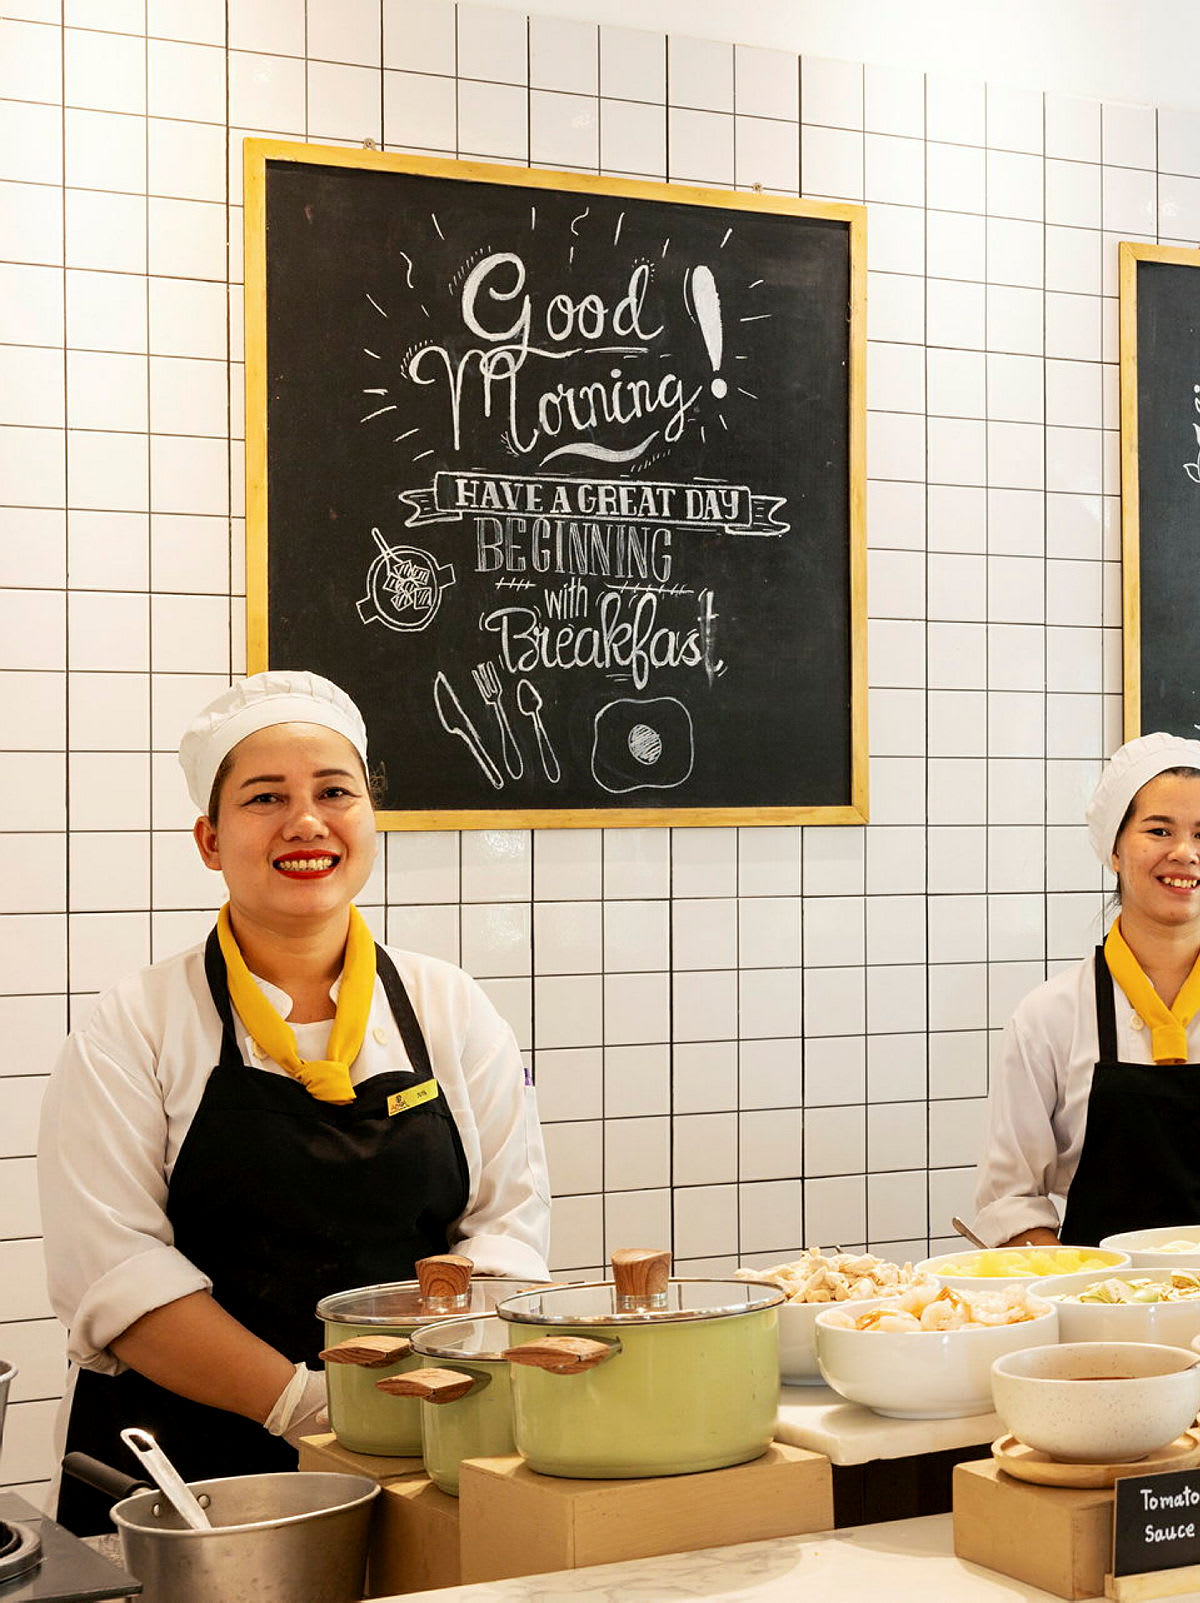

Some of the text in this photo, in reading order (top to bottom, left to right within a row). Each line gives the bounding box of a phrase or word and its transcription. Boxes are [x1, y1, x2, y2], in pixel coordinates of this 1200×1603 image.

[461, 252, 665, 358] Good
[455, 478, 740, 521] HAVE A GREAT DAY
[473, 517, 672, 583] BEGINNING
[544, 577, 589, 620] with
[1140, 1485, 1200, 1512] Tomato
[1145, 1522, 1196, 1543] Sauce
